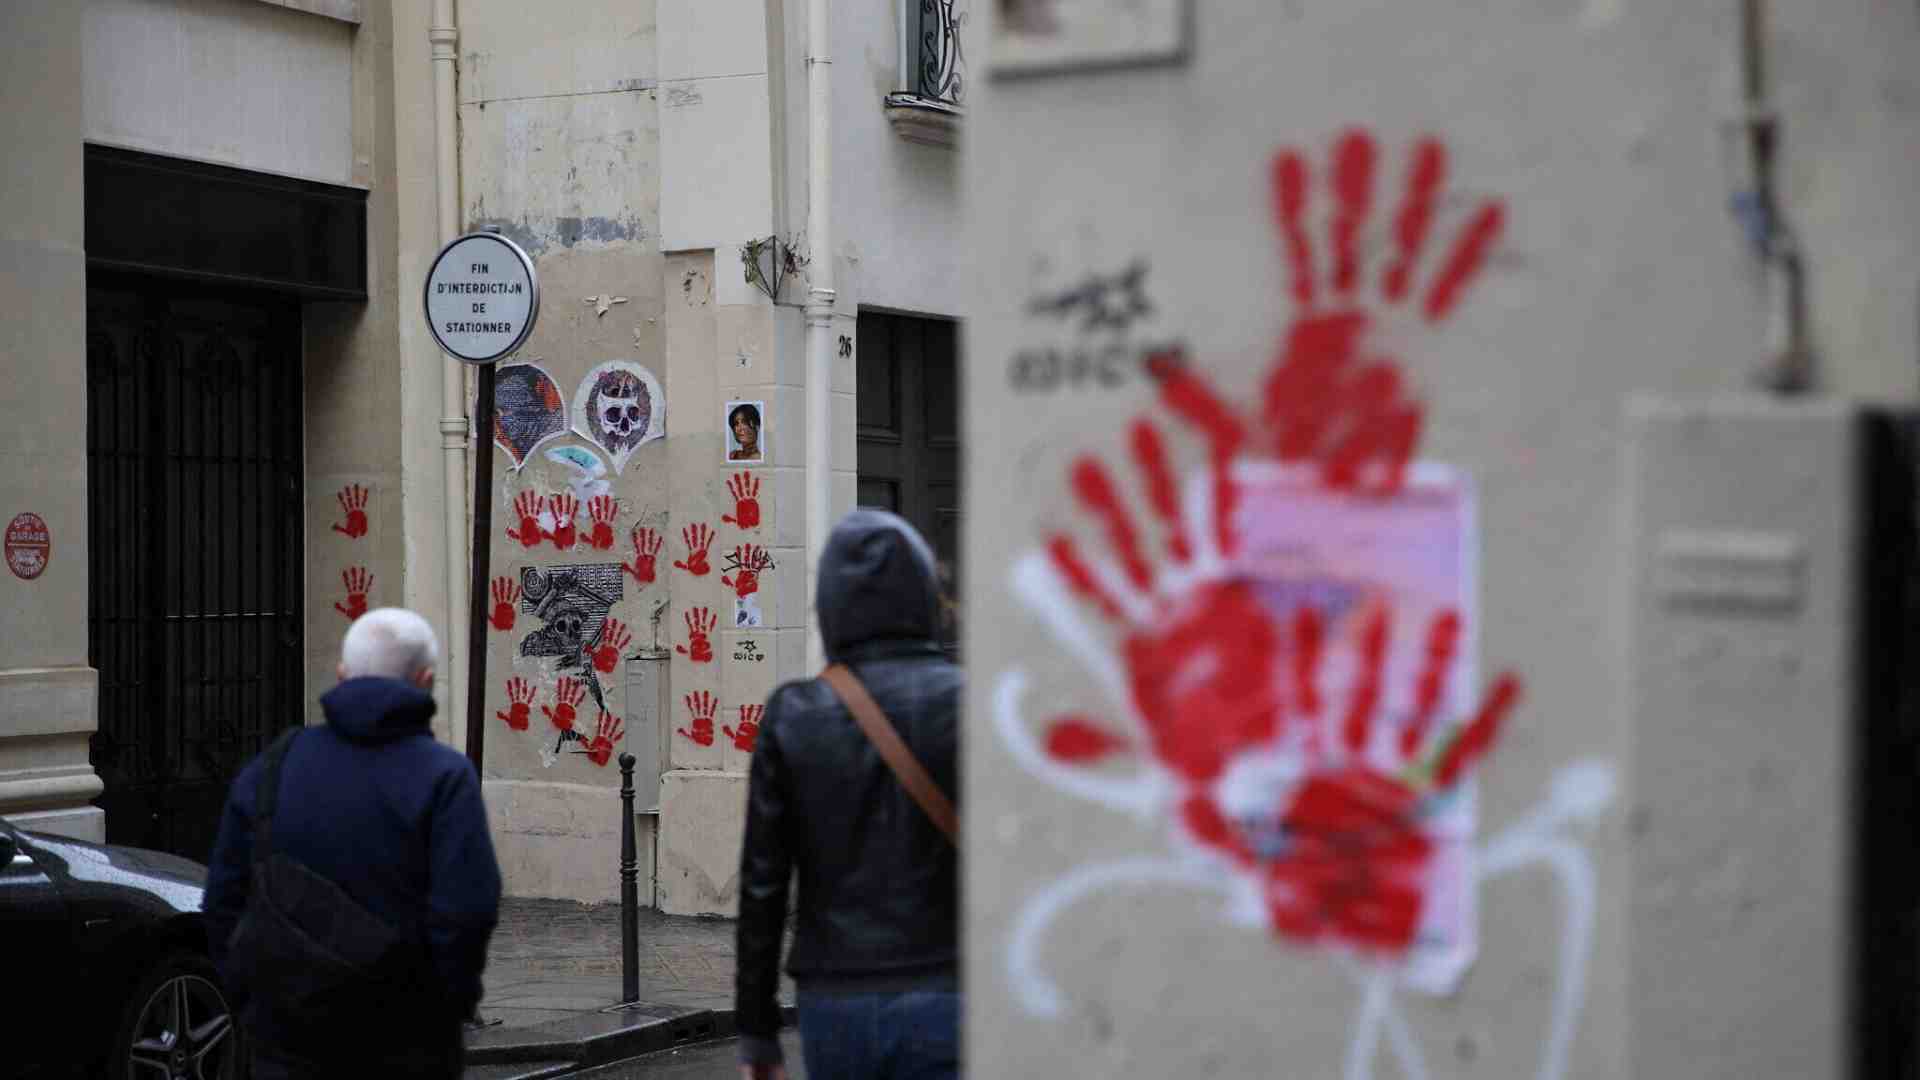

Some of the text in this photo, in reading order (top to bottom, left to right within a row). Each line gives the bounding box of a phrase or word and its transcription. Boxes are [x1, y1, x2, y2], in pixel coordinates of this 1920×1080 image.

[471, 263, 489, 274] FIN
[472, 302, 486, 313] DE
[446, 322, 511, 333] STATIONNER
[839, 335, 852, 358] 26
[10, 531, 48, 542] GARAGE
